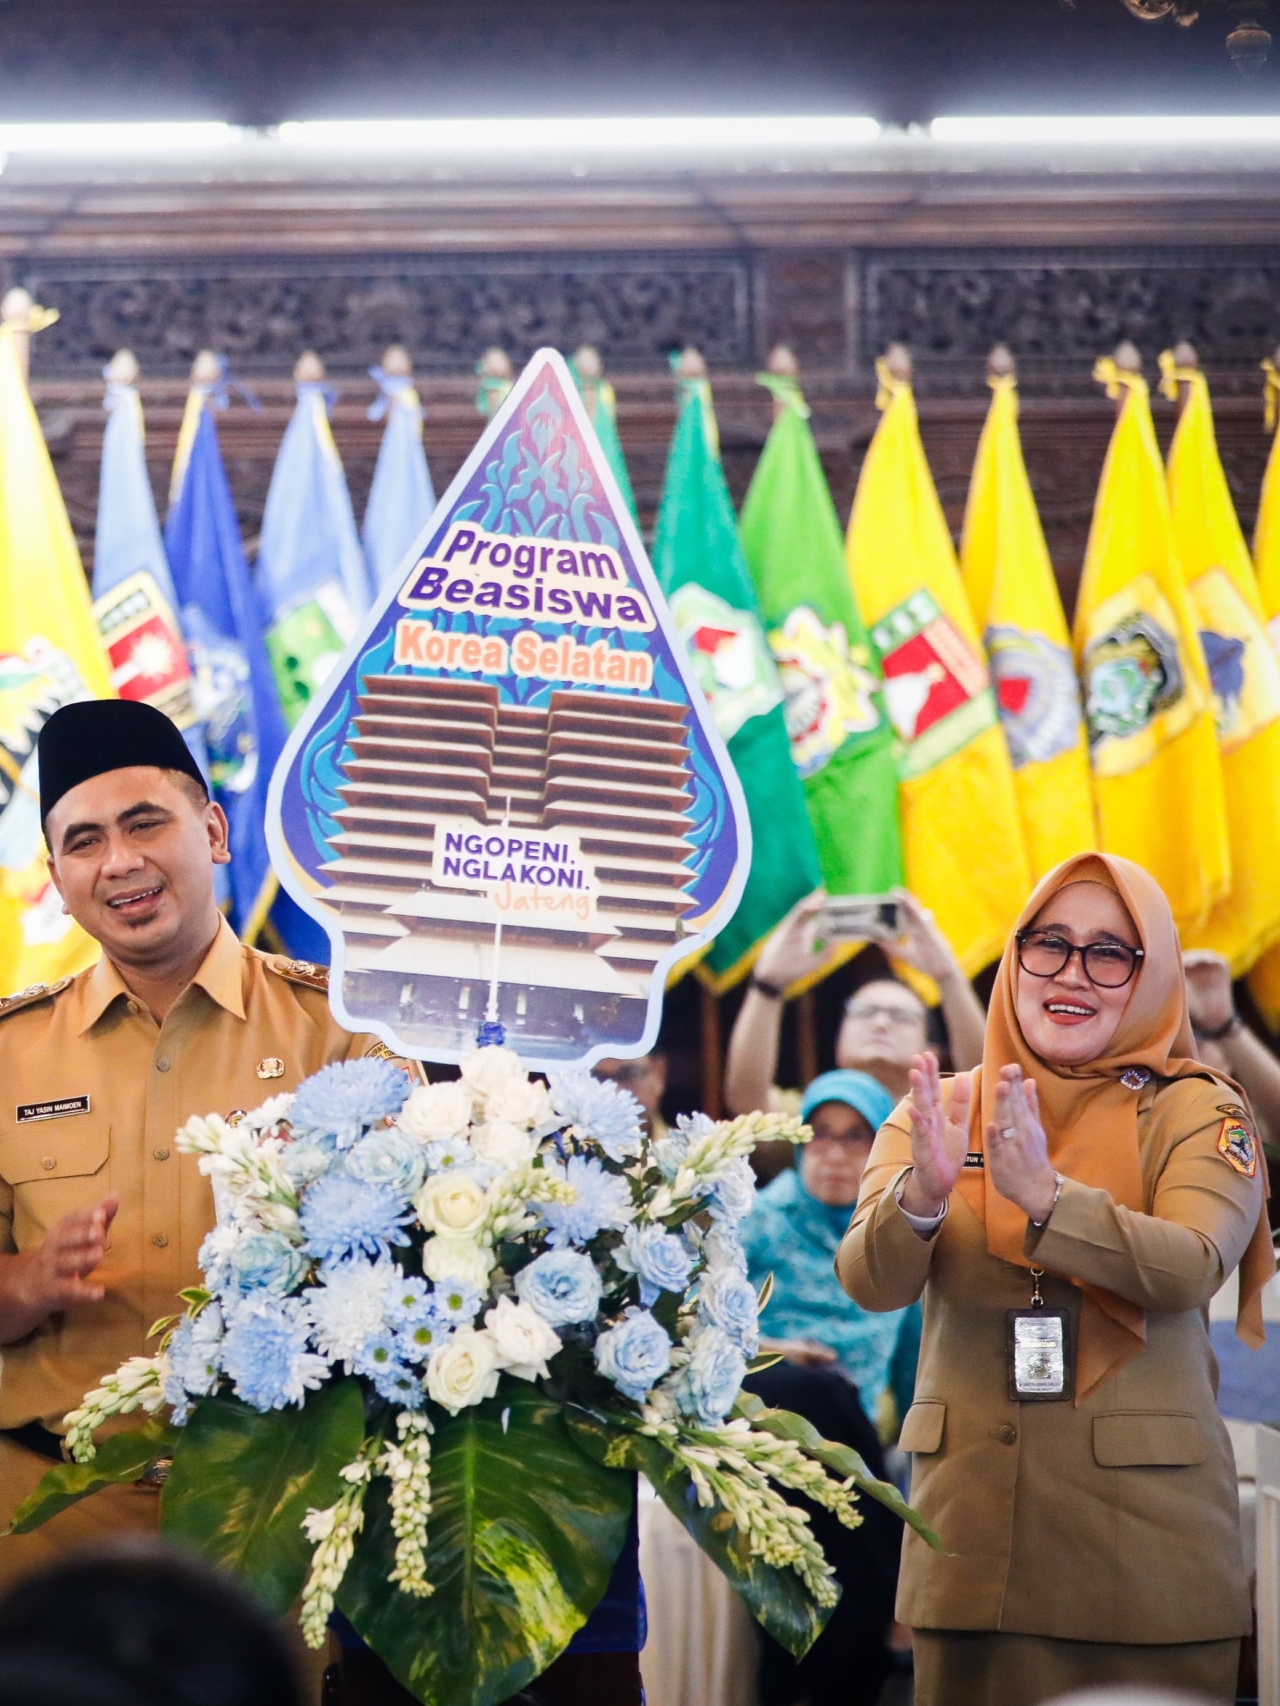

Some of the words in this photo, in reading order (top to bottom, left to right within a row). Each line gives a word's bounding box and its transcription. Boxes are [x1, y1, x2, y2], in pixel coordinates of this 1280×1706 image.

[441, 528, 620, 581] Program
[406, 565, 649, 625] Beasiswa
[399, 623, 504, 670] Korea
[515, 636, 649, 685] Selatan
[444, 832, 576, 865] NGOPENI.
[442, 856, 591, 891] NGLAKONI.
[494, 879, 590, 921] Jateng
[24, 1108, 35, 1116] TAJ
[36, 1106, 53, 1114] YASIN
[54, 1101, 82, 1111] MAIMOEN
